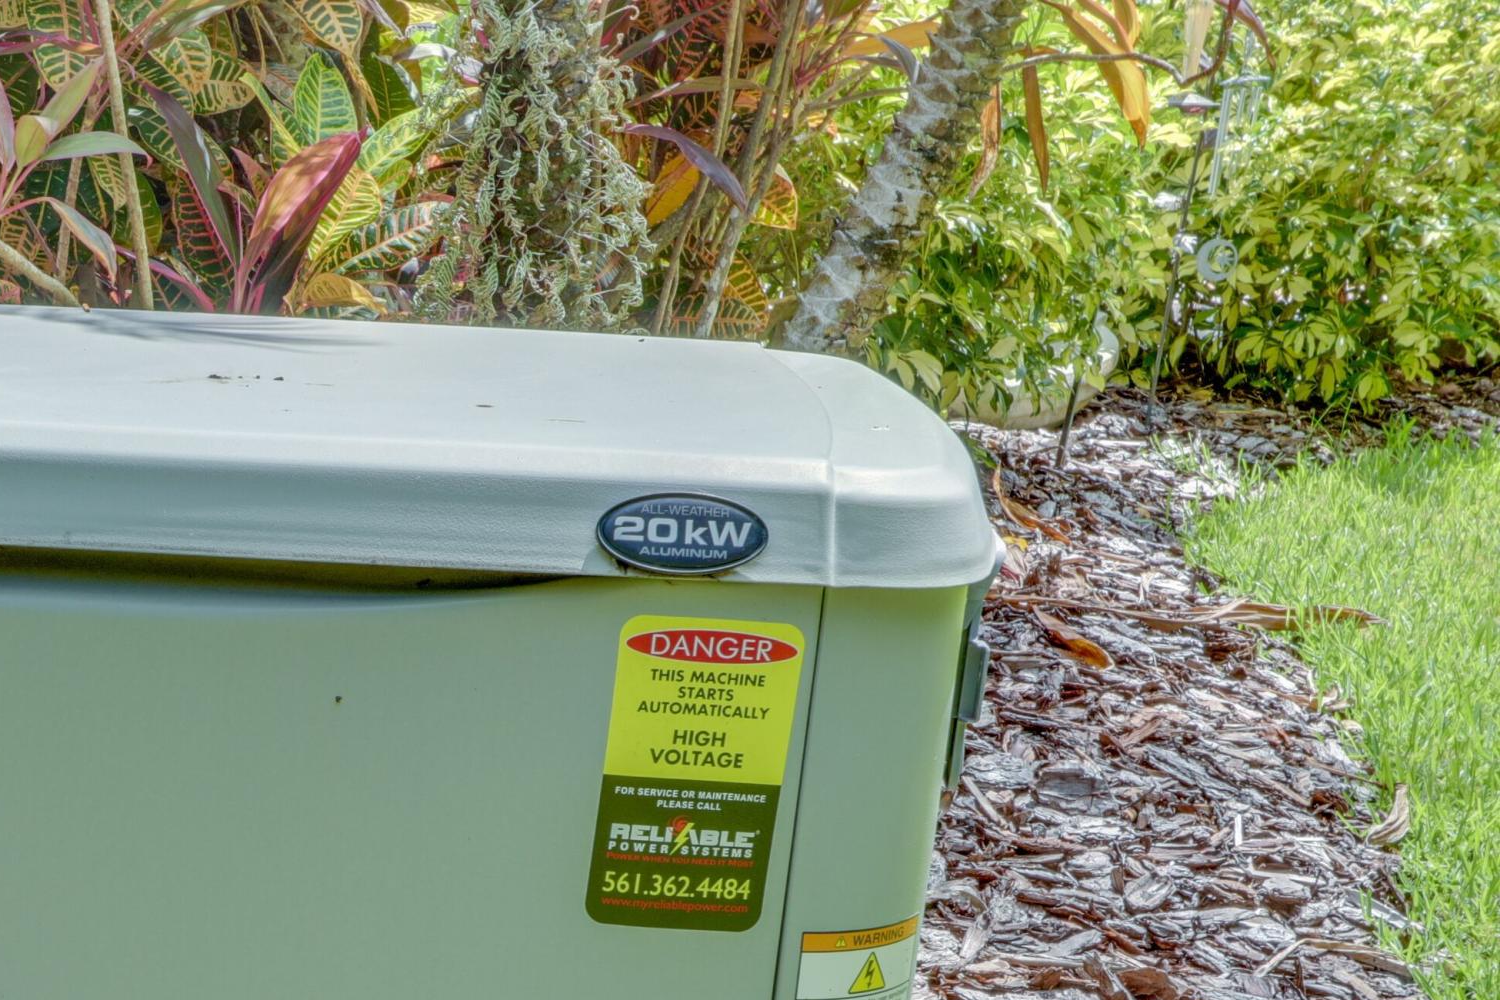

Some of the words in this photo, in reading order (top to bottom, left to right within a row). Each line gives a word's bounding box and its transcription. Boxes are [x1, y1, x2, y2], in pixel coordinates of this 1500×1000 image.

[641, 504, 730, 518] ALL-WEATHER
[639, 546, 728, 560] ALUMINUM
[649, 633, 773, 662] DANGER
[650, 668, 685, 682] THIS
[689, 671, 766, 687] MACHINE
[678, 686, 734, 701] STARTS
[637, 700, 770, 720] AUTOMATICALLY
[672, 729, 726, 747] HIGH
[650, 748, 744, 768] VOLTAGE
[614, 785, 635, 796] FOR
[637, 787, 678, 798] SERVICE
[680, 790, 696, 799] OR
[697, 791, 767, 803] MAINTENANCE
[656, 799, 695, 809] PLEASE
[697, 801, 722, 811] CALL
[608, 844, 670, 855] POWER
[680, 847, 753, 858] SYSTEMS
[602, 871, 751, 900] 561.362.4484
[602, 896, 750, 913] www.myreliablepower.com
[853, 927, 905, 946] WARNING
